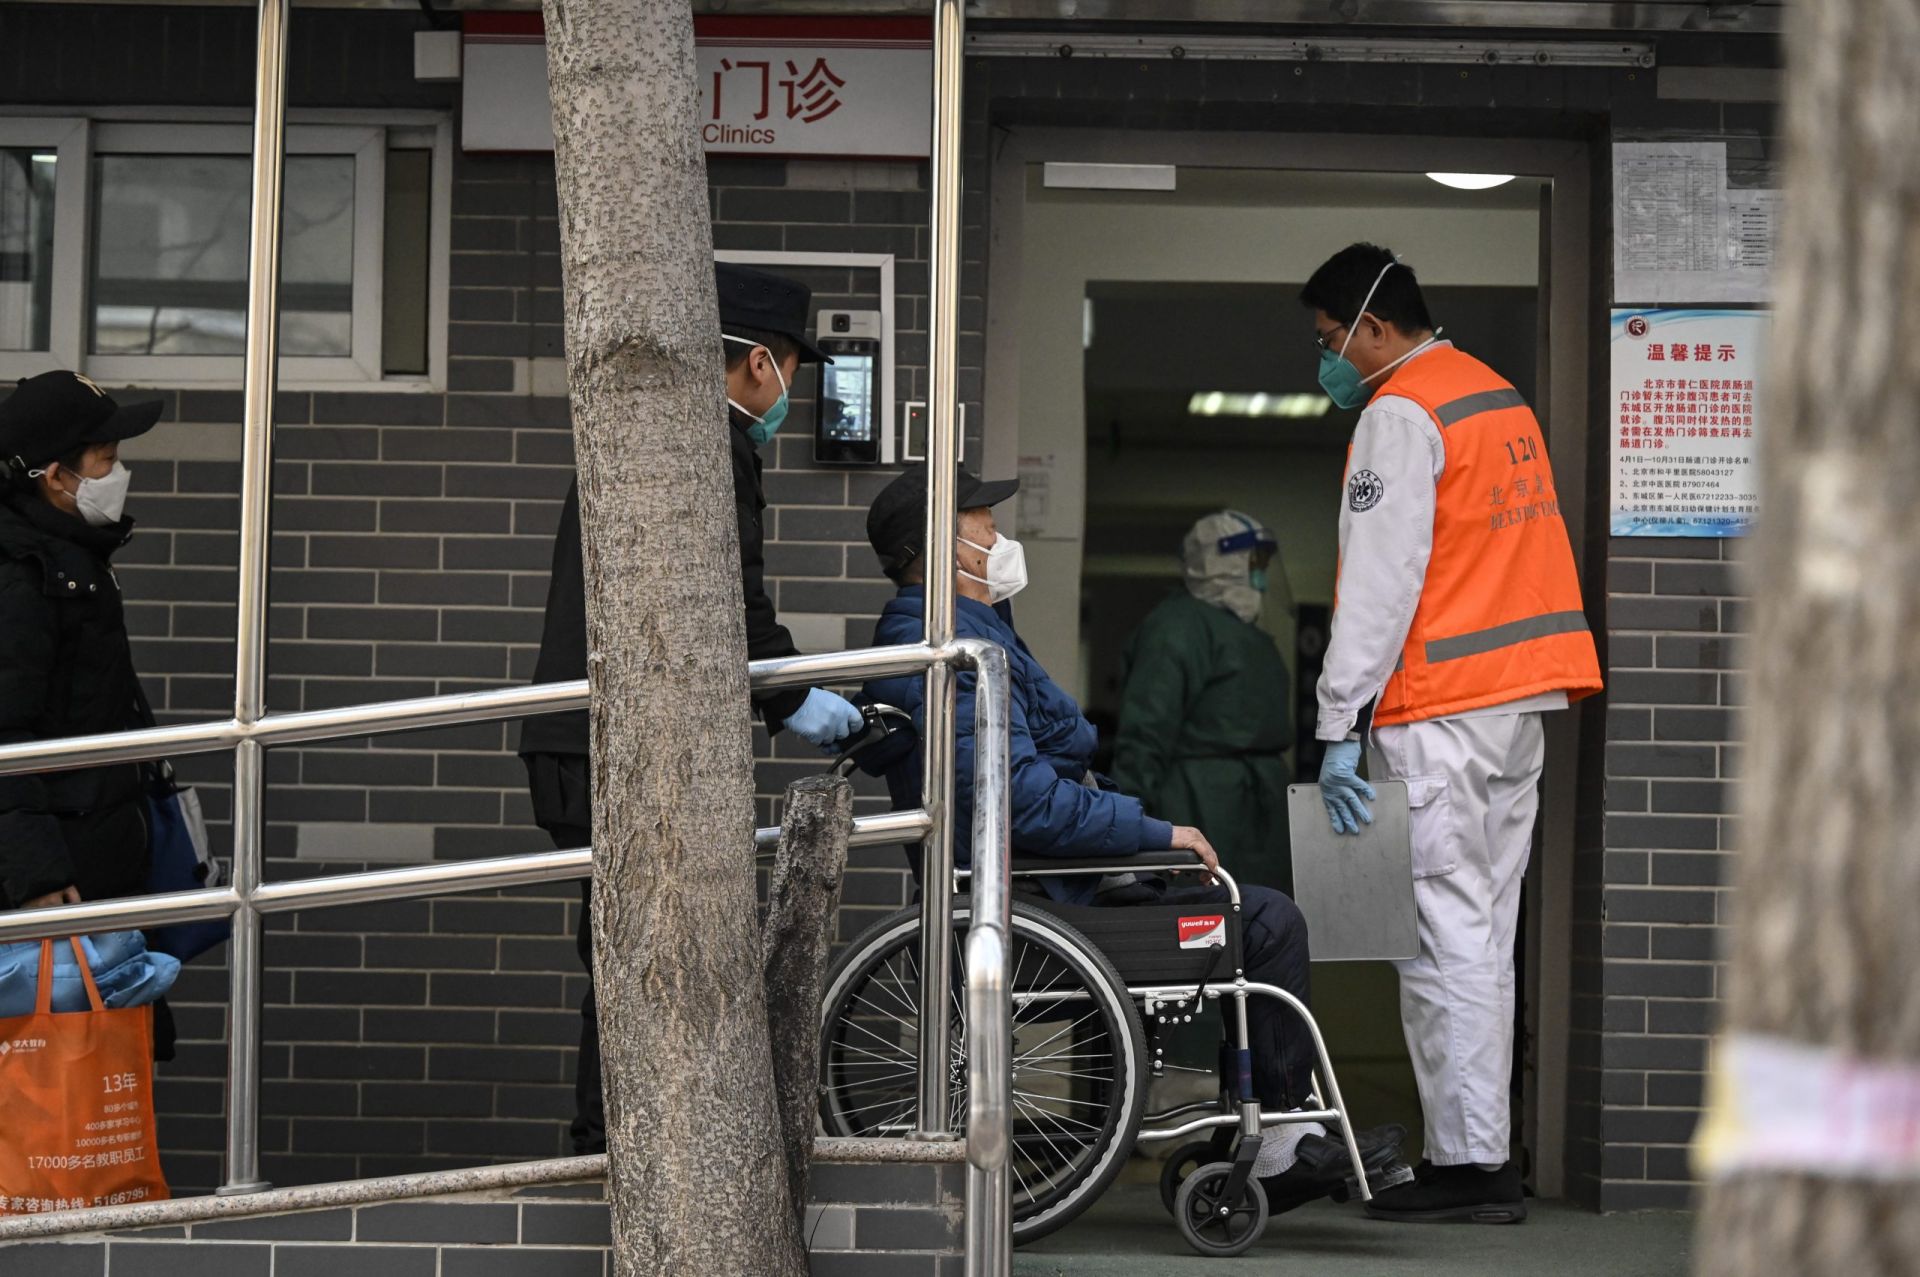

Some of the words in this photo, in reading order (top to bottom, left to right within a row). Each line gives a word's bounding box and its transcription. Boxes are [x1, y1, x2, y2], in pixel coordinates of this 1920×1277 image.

[712, 57, 846, 123] 门诊
[702, 123, 775, 144] Clinics
[1647, 343, 1736, 362] 温馨提示
[1643, 378, 1753, 390] 北京市普仁医院原肠道
[1505, 436, 1537, 465] 120
[103, 1072, 137, 1094] 13年
[28, 1147, 145, 1170] 17000多名教职员工
